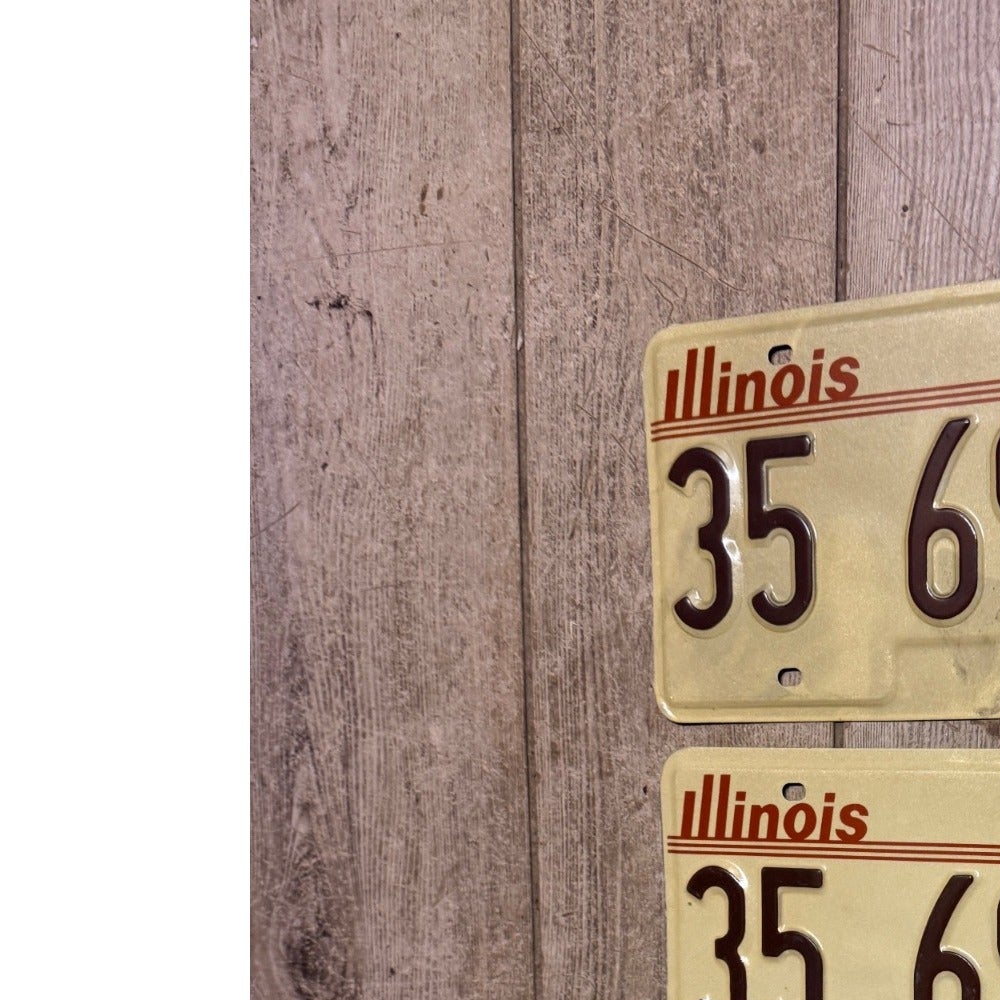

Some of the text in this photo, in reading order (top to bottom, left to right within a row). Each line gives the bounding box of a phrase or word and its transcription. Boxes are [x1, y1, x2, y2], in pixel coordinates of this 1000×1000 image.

[662, 346, 860, 421] Illinois
[668, 434, 815, 631] 35
[680, 774, 869, 842] Illinois
